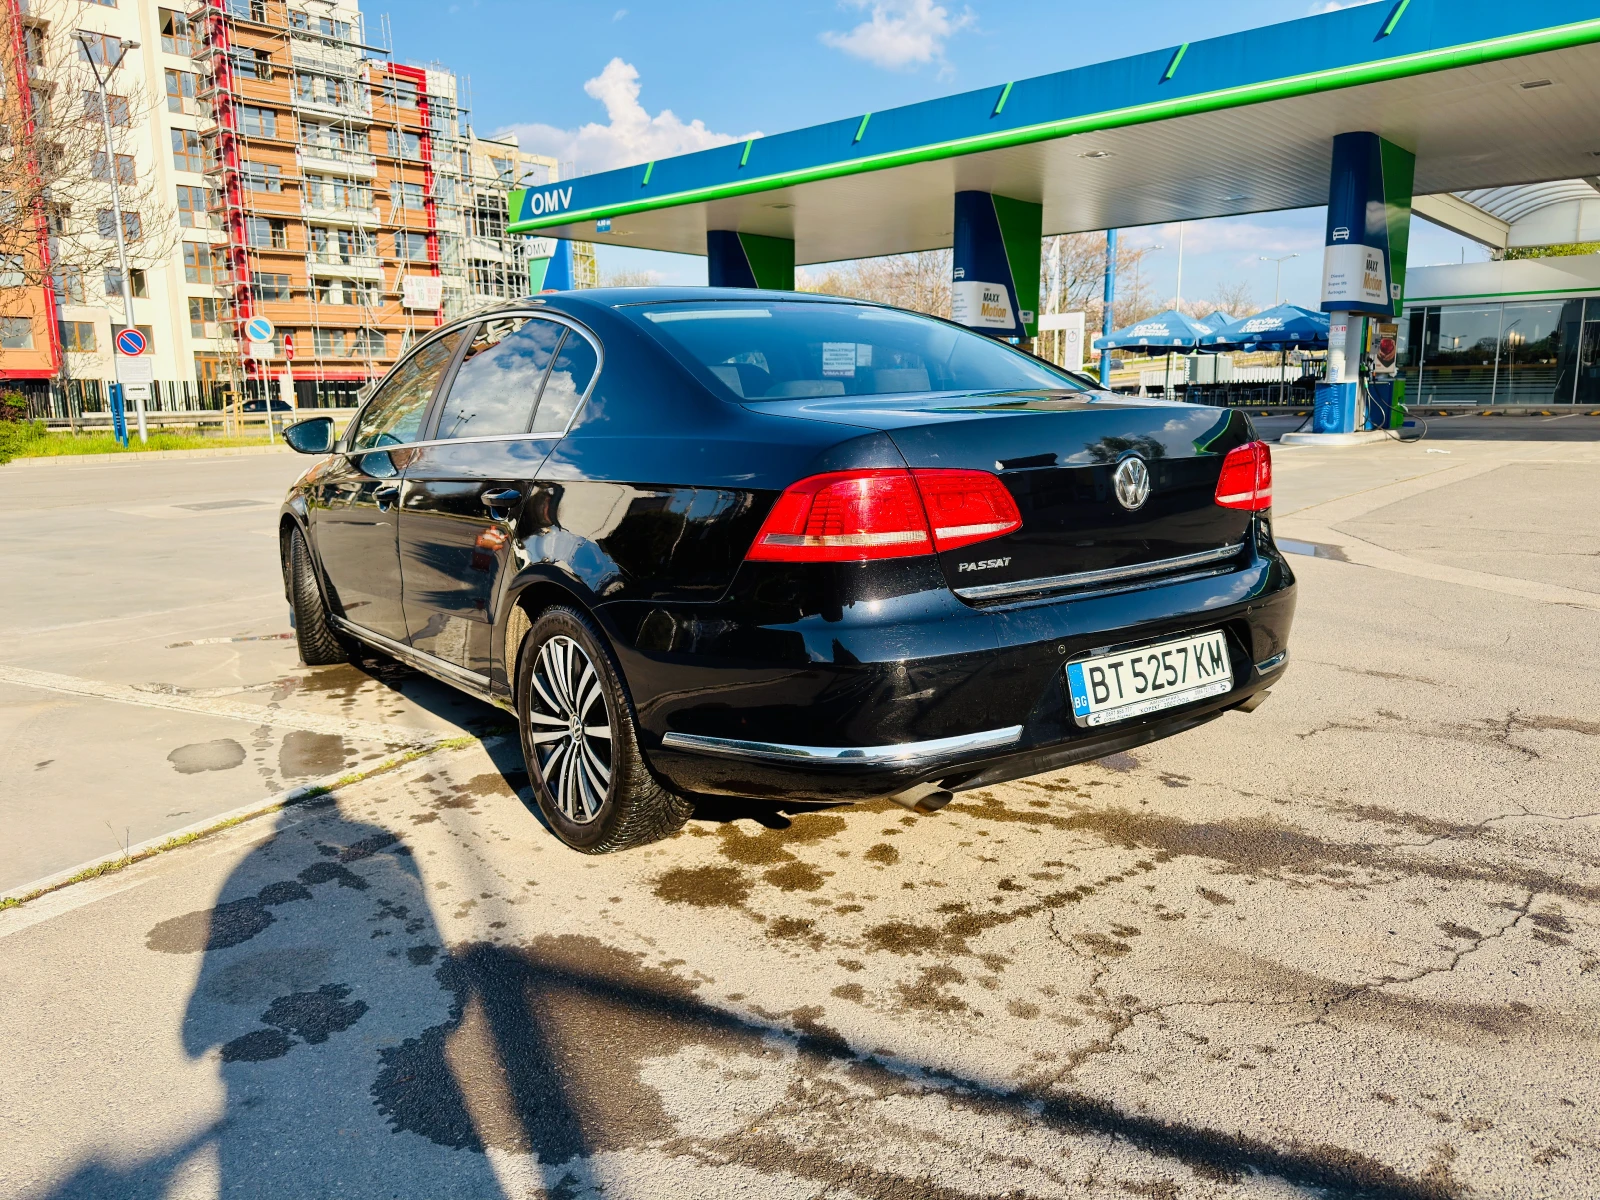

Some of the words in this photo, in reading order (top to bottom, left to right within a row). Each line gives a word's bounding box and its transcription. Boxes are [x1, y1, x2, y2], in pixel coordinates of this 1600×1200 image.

[531, 186, 573, 215] OMV
[526, 242, 548, 256] OMV
[1365, 259, 1379, 272] MAXX
[1363, 272, 1382, 291] Motion
[982, 292, 1000, 303] MAXX
[981, 303, 1007, 318] Motion
[958, 556, 1012, 573] PASSAT
[1089, 661, 1124, 705] BT
[1130, 647, 1188, 694] 5257
[1193, 639, 1226, 679] KM
[1074, 695, 1087, 709] BG
